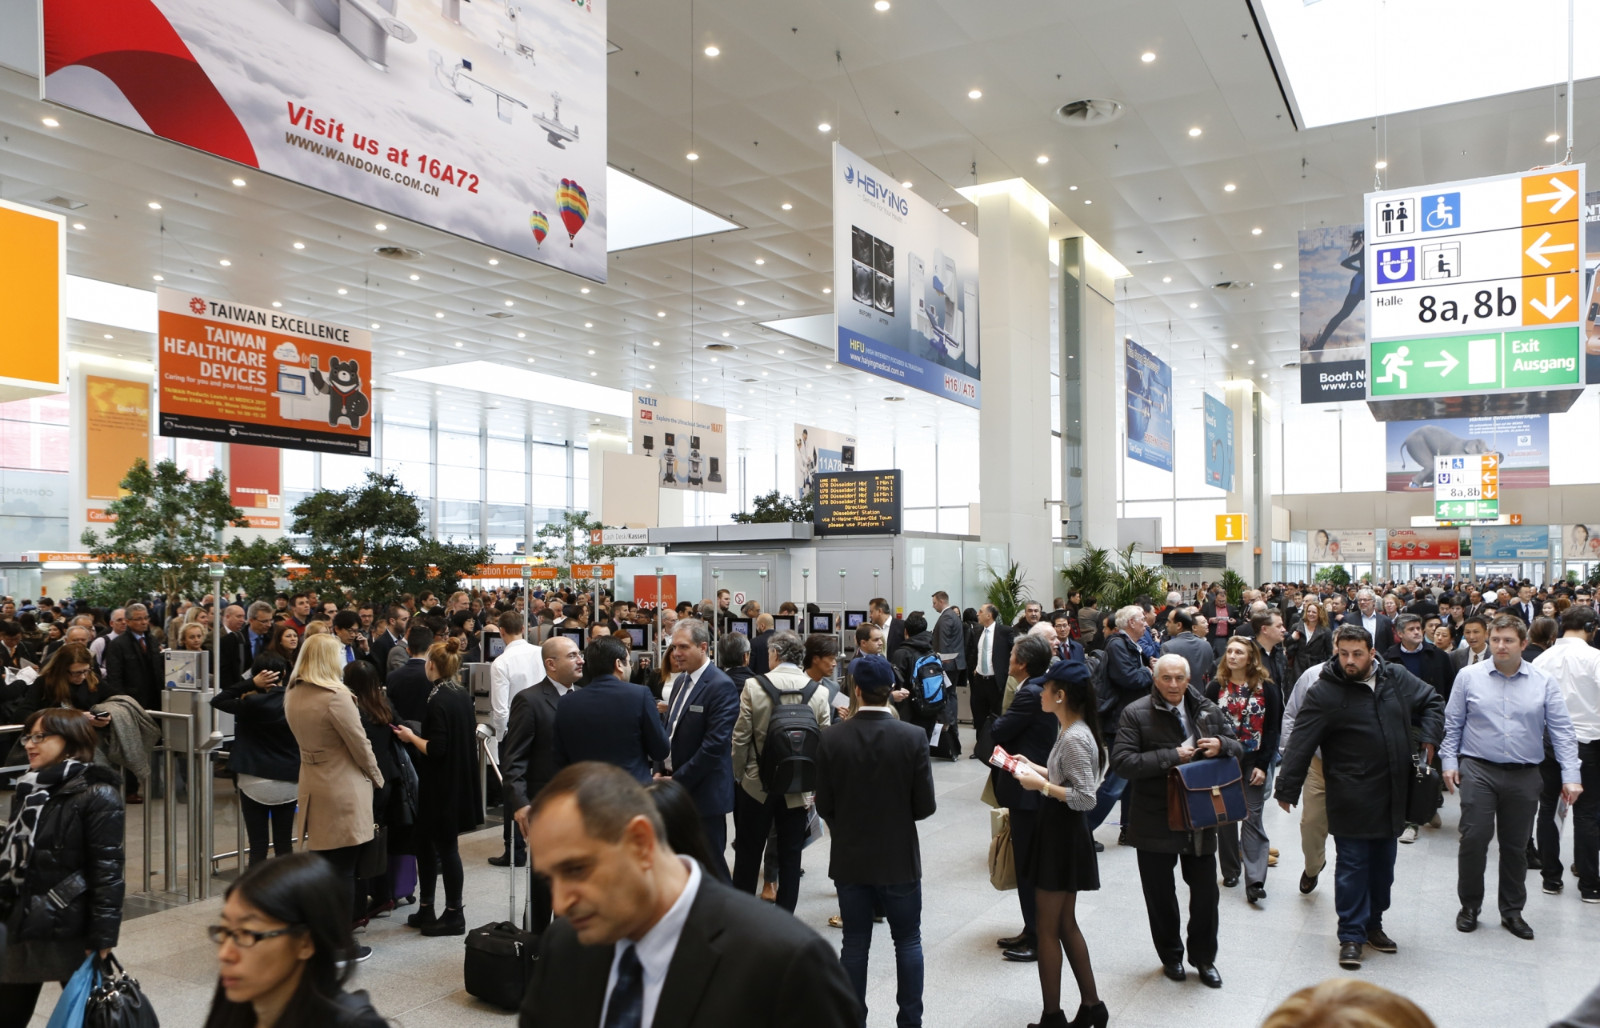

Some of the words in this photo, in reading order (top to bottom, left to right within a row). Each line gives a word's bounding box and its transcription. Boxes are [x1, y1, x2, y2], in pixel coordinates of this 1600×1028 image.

[287, 101, 345, 143] Visit
[352, 133, 380, 155] us
[387, 147, 409, 167] at
[418, 154, 479, 194] 16A72
[285, 131, 440, 197] WWW.WANDONG.COM.CN
[1377, 296, 1403, 308] Halle
[1418, 287, 1517, 324] 8a,8b
[209, 301, 267, 326] TAIWAN
[271, 315, 350, 343] EXCELLENCE
[204, 325, 267, 351] TAIWAN
[849, 338, 865, 353] HIFU
[1512, 339, 1540, 354] Exit
[163, 336, 267, 369] HEALTHCARE
[200, 361, 267, 385] DEVICES
[1319, 371, 1353, 383] Booth
[1355, 370, 1367, 380] N
[1513, 357, 1575, 374] Ausgang
[638, 396, 657, 407] SIUI
